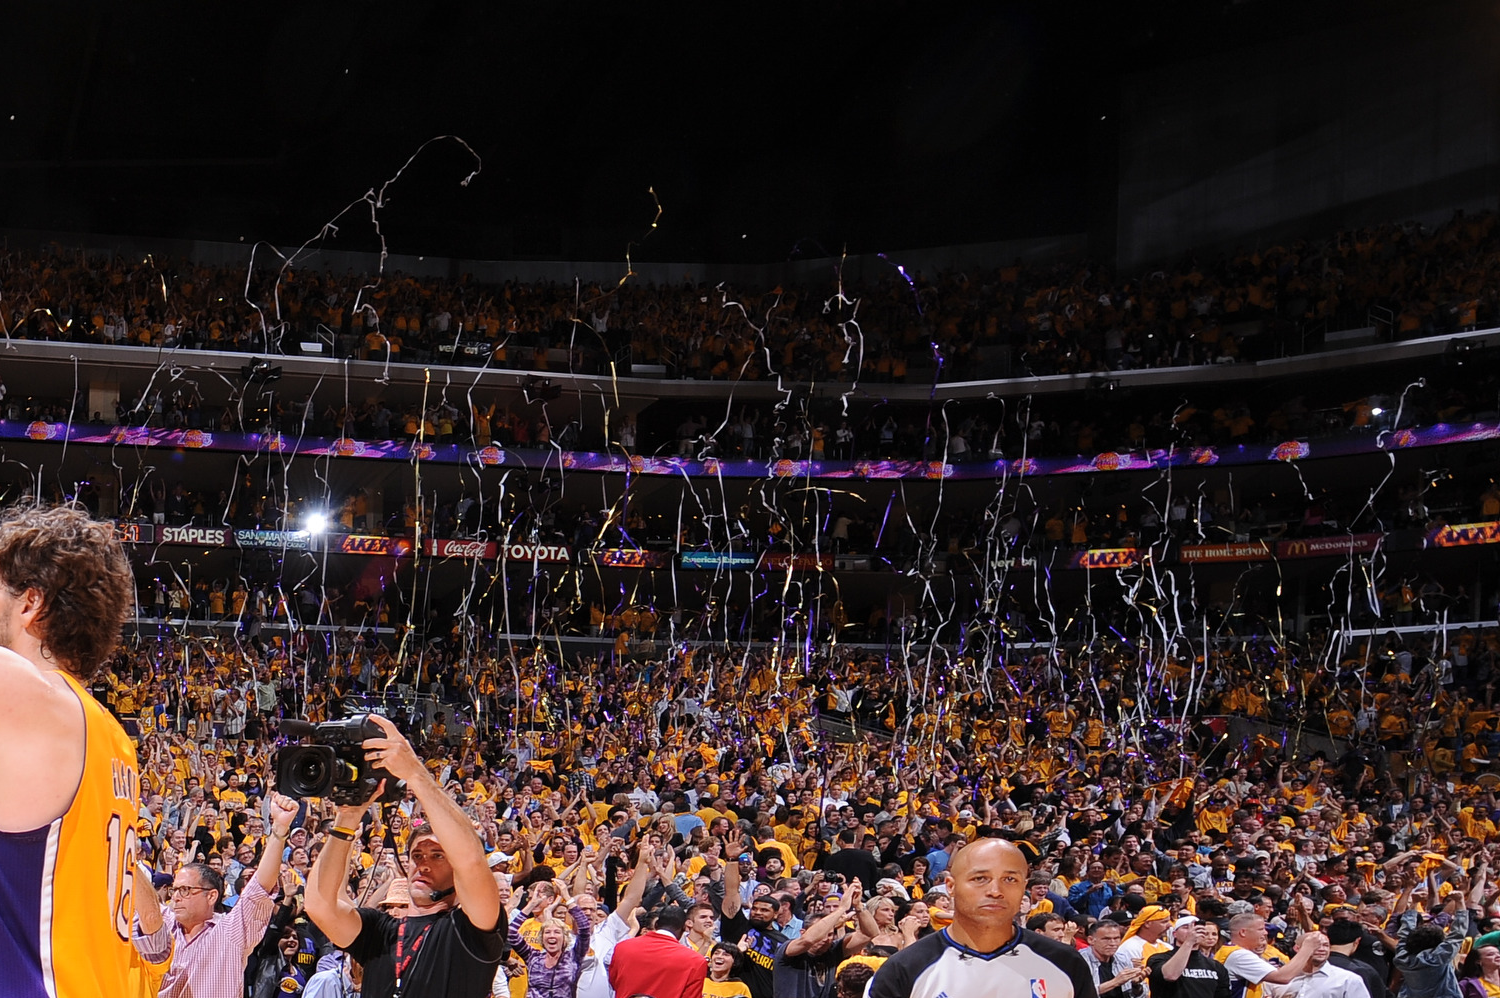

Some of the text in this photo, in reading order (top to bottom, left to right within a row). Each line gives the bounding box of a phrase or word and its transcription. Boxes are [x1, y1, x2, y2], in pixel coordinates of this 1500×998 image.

[162, 527, 224, 545] STAPLES
[237, 530, 258, 540] SAN
[503, 545, 570, 561] TOYOTA
[1182, 549, 1201, 559] THE
[722, 557, 754, 565] Express
[991, 556, 1036, 568] verion
[106, 812, 137, 943] 16
